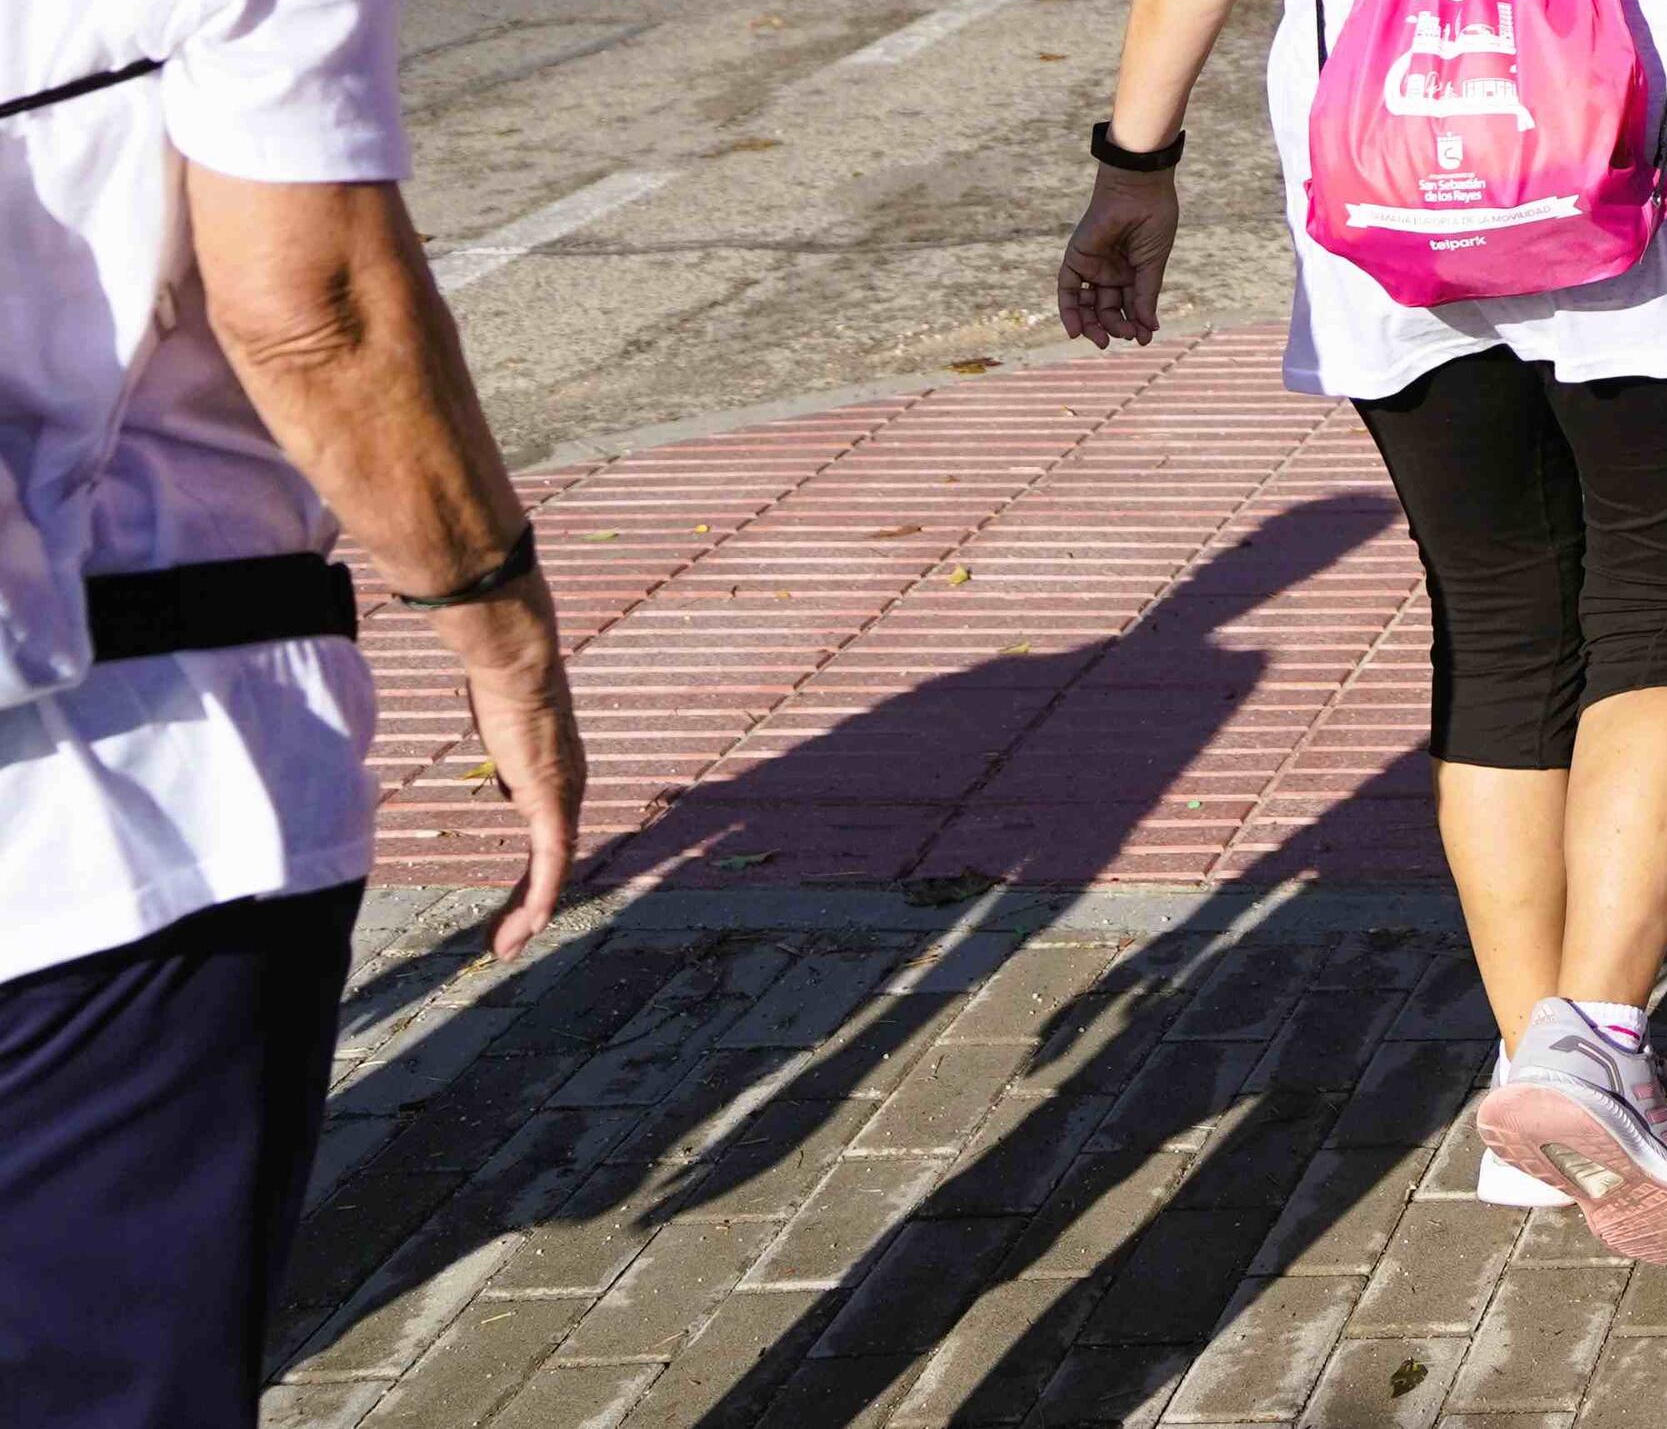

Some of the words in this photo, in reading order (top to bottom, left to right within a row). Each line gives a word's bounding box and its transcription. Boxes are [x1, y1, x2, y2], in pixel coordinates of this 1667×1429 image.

[1418, 179, 1437, 191] San
[1438, 190, 1453, 202] los
[1453, 190, 1483, 203] Reyes
[1430, 235, 1487, 251] telpark
